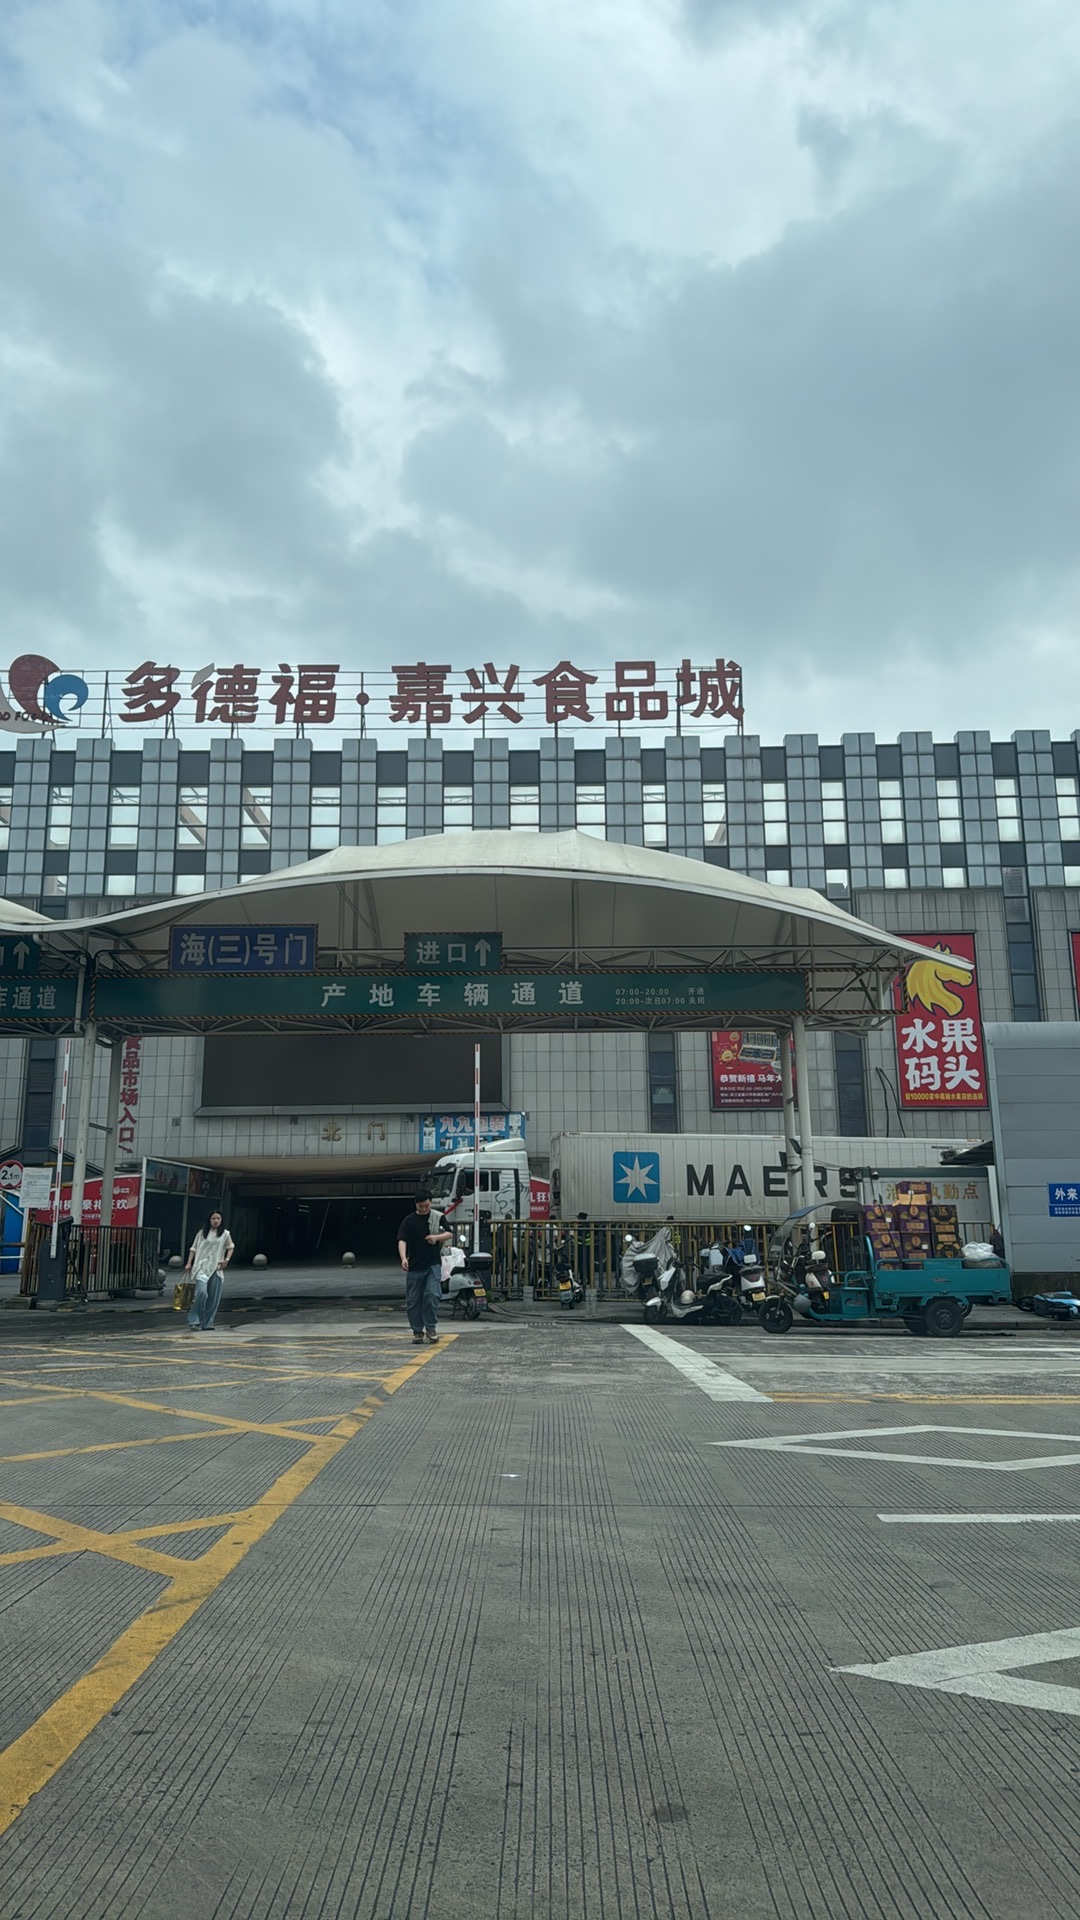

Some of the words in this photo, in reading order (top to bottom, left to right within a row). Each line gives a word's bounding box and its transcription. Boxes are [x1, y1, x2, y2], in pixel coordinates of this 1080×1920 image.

[180, 933, 307, 965] 海(三)号门
[416, 941, 467, 965] 进口
[321, 981, 584, 1008] 产地车辆通道
[901, 1018, 978, 1054] 水果
[757, 1073, 783, 1083] 马年大
[904, 1055, 982, 1092] 码头
[440, 1115, 507, 1133] 九九包装
[686, 1151, 858, 1198] MAERS
